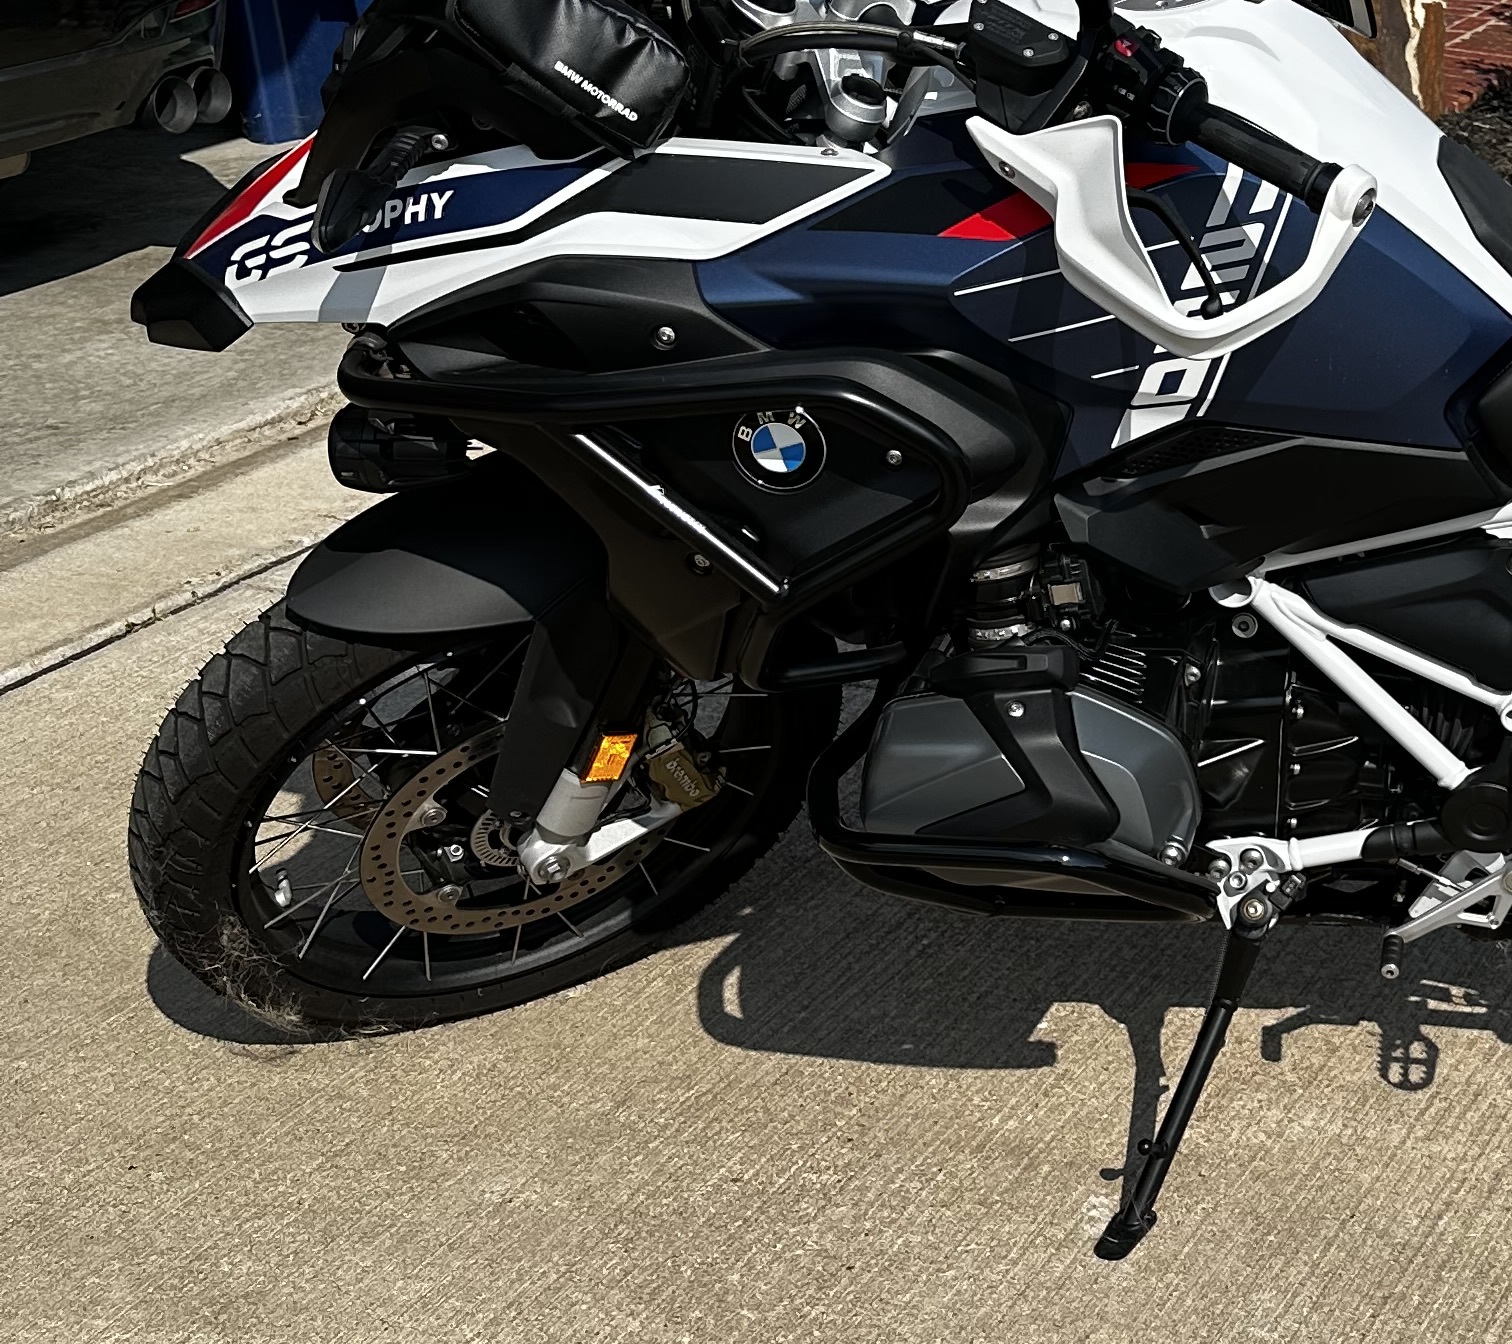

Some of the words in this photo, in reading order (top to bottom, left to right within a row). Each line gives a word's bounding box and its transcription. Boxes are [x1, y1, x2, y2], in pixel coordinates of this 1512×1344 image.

[553, 60, 583, 85] BMW
[580, 79, 639, 122] MOTORRAD
[225, 220, 313, 286] GS
[737, 411, 807, 442] BMW
[665, 757, 701, 797] brembo
